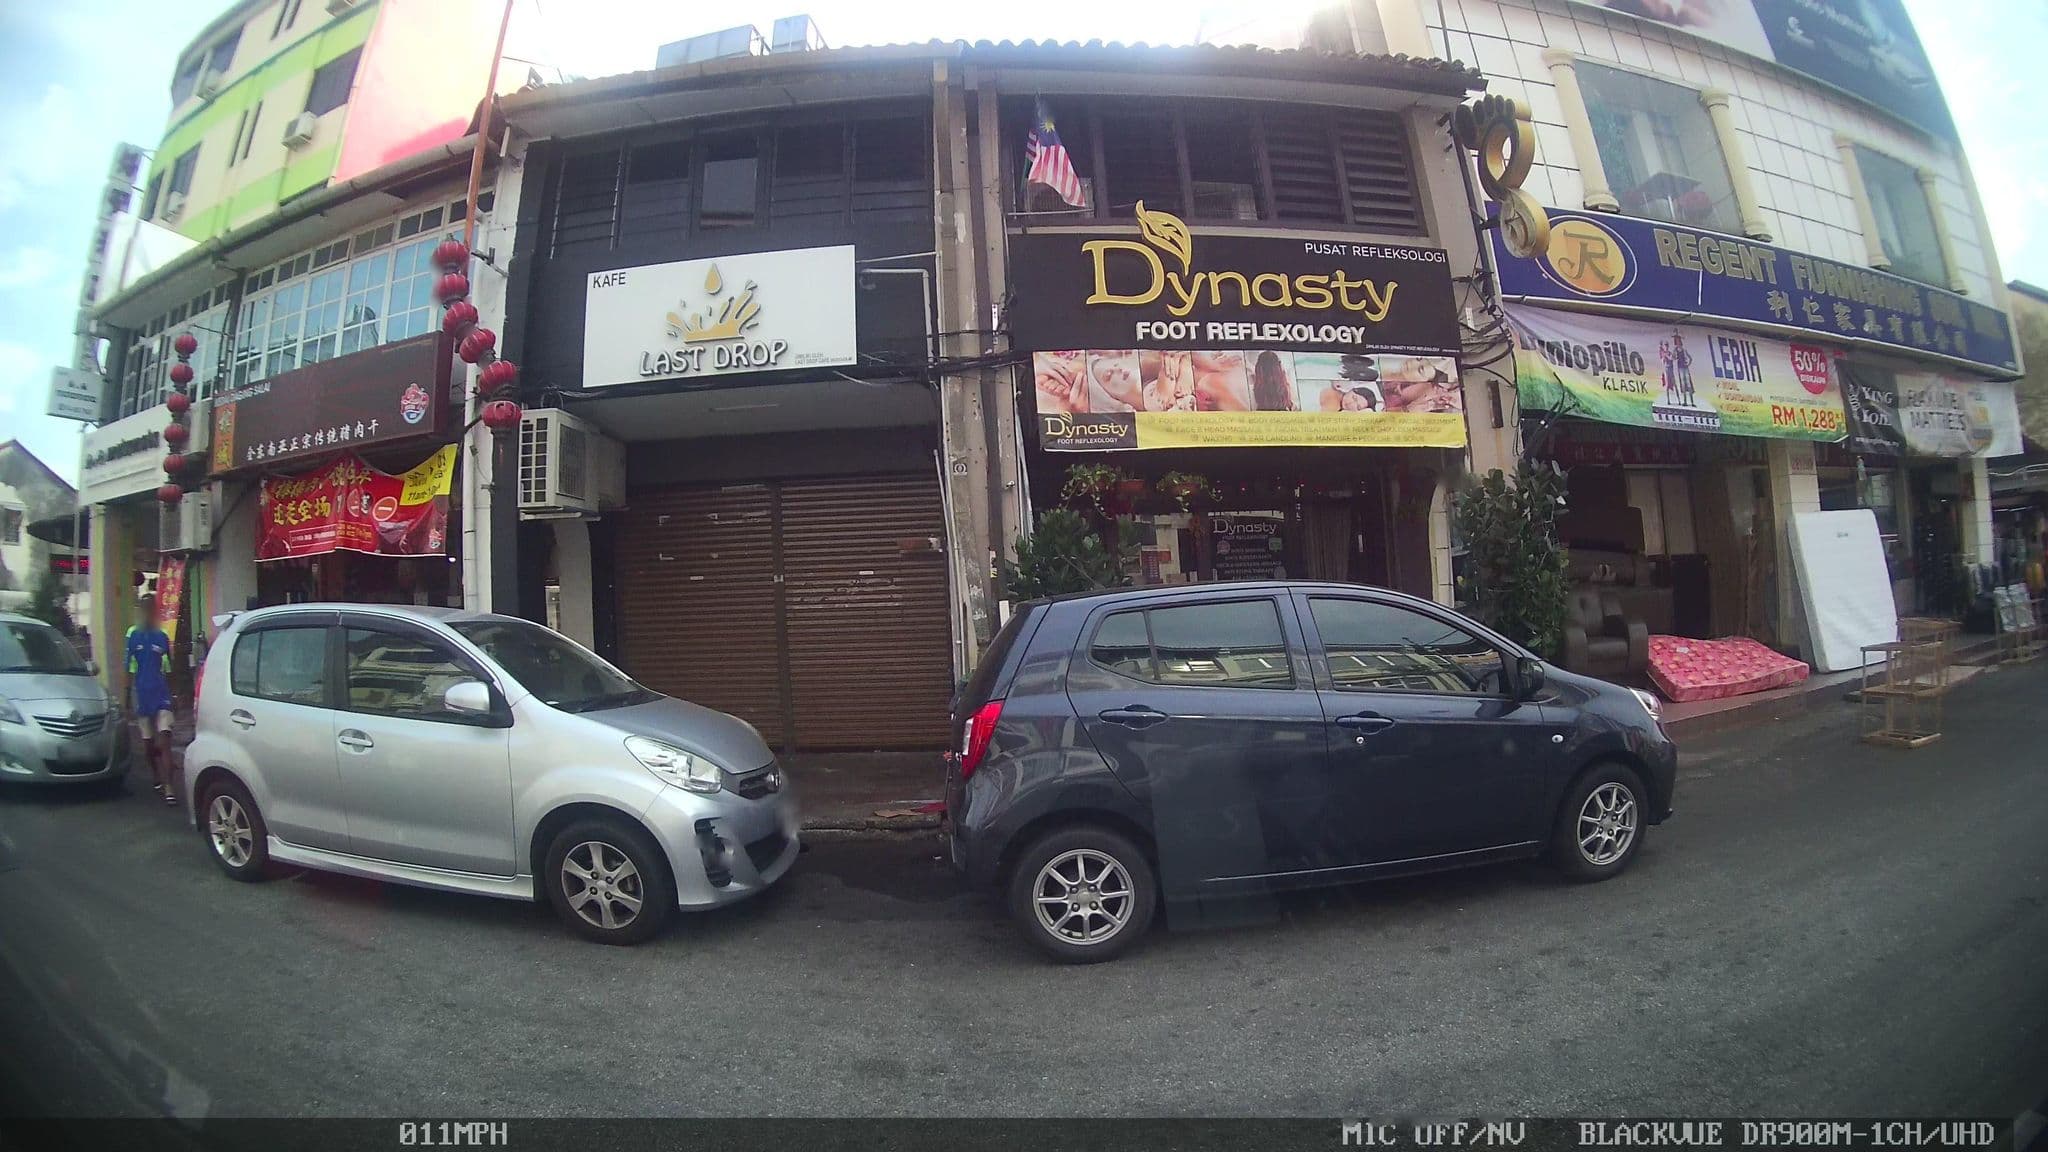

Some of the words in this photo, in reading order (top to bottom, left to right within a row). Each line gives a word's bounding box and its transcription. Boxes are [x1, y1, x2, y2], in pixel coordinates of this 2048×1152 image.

[1304, 242, 1348, 256] PUSAT
[1352, 245, 1447, 263] REFLEKSOLOGI
[1653, 228, 1777, 285] REGENT
[592, 272, 627, 289] KAFE
[1081, 240, 1398, 322] Dynasty
[1136, 321, 1200, 341] FOOT
[1207, 322, 1366, 345] REFLEXOLOGY
[638, 345, 705, 377] LAST
[713, 339, 788, 371] DROP
[1707, 335, 1763, 383] LEBIH
[1794, 350, 1826, 373] 50%
[1602, 376, 1649, 395] KLASIK
[1771, 404, 1797, 426] RM
[1044, 417, 1129, 438] Dynasty
[1212, 518, 1277, 536] Dynasty
